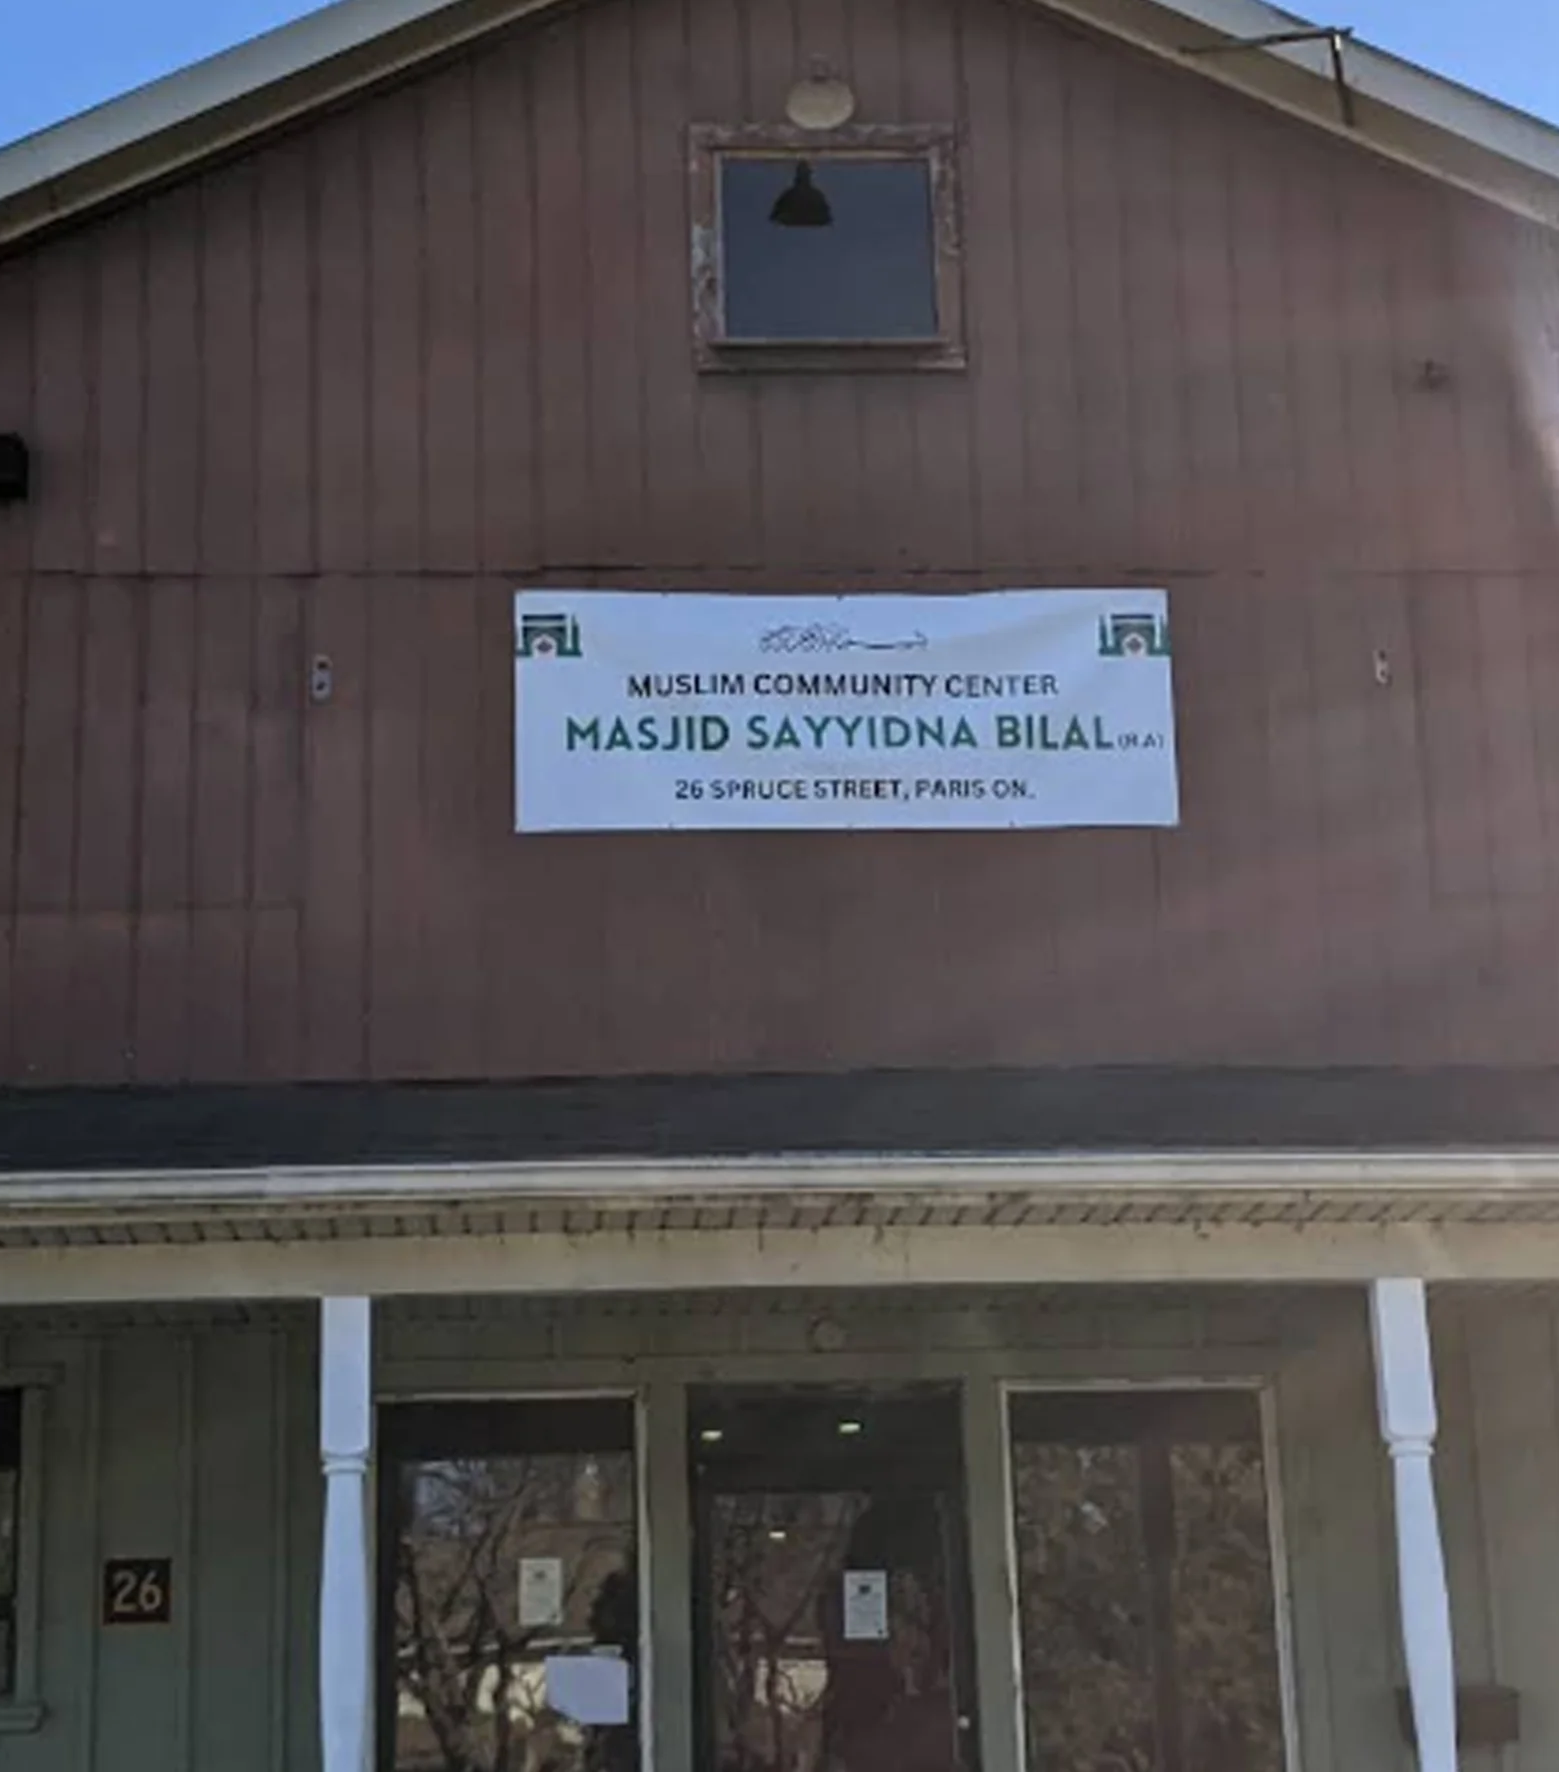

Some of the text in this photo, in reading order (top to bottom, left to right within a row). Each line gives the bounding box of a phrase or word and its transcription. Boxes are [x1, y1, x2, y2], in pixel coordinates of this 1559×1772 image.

[627, 673, 1059, 698] MUSLIM COMMUNITY CENTER
[565, 714, 730, 752] MASJID
[746, 714, 978, 750] SAYYIDNA
[996, 714, 1114, 750] BILAL
[674, 779, 704, 800] 26
[710, 779, 808, 800] SPRUCE
[813, 778, 910, 801] STREET,
[915, 778, 986, 799] PARIS
[113, 1569, 162, 1612] 26
